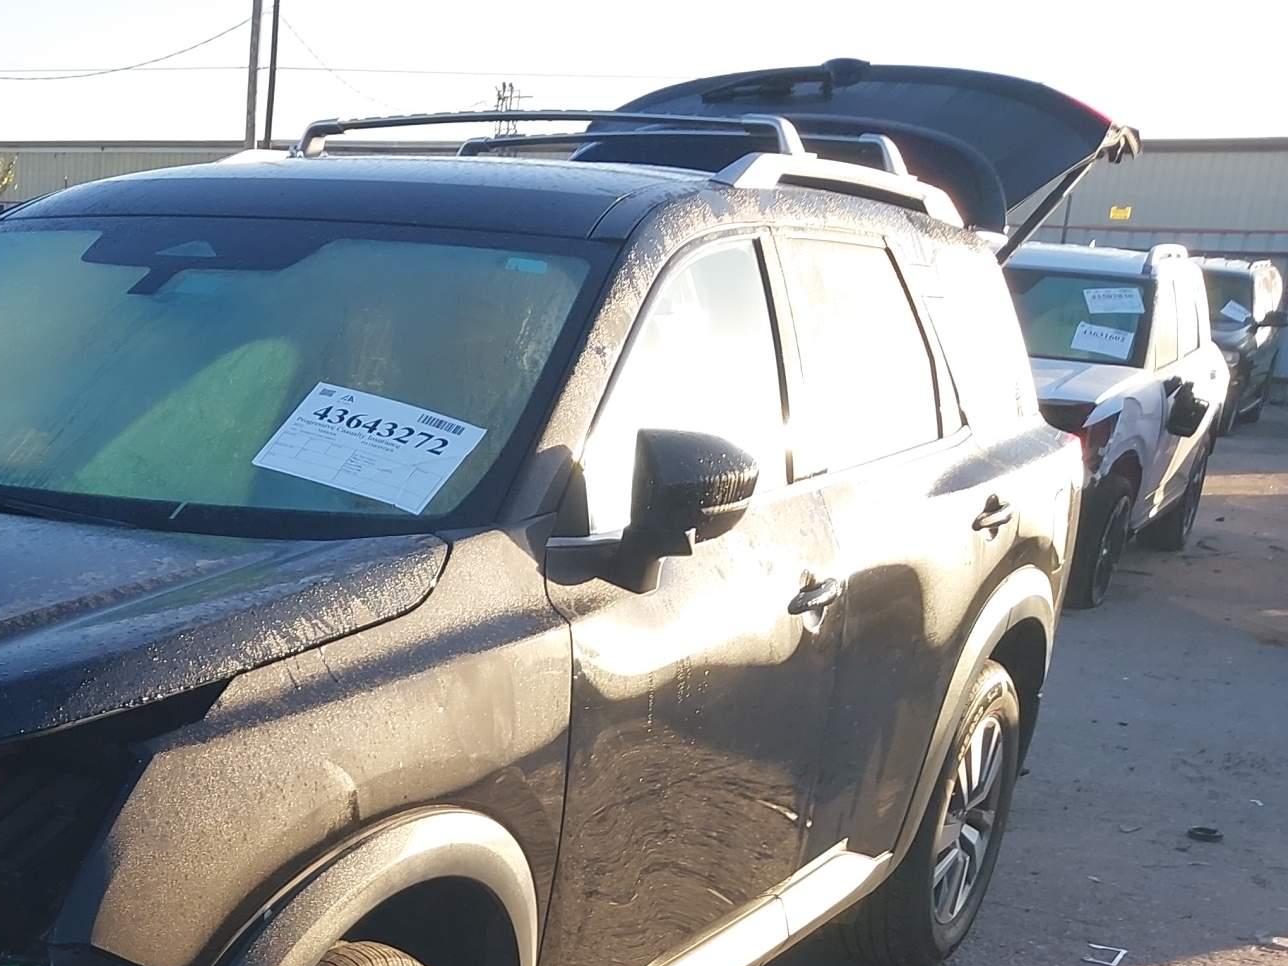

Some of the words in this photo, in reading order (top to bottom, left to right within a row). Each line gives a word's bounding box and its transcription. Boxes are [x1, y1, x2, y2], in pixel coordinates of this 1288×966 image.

[296, 416, 335, 431] Progressive
[336, 426, 366, 440] Casualty
[367, 436, 402, 450] Insurance
[312, 404, 449, 456] 43643272
